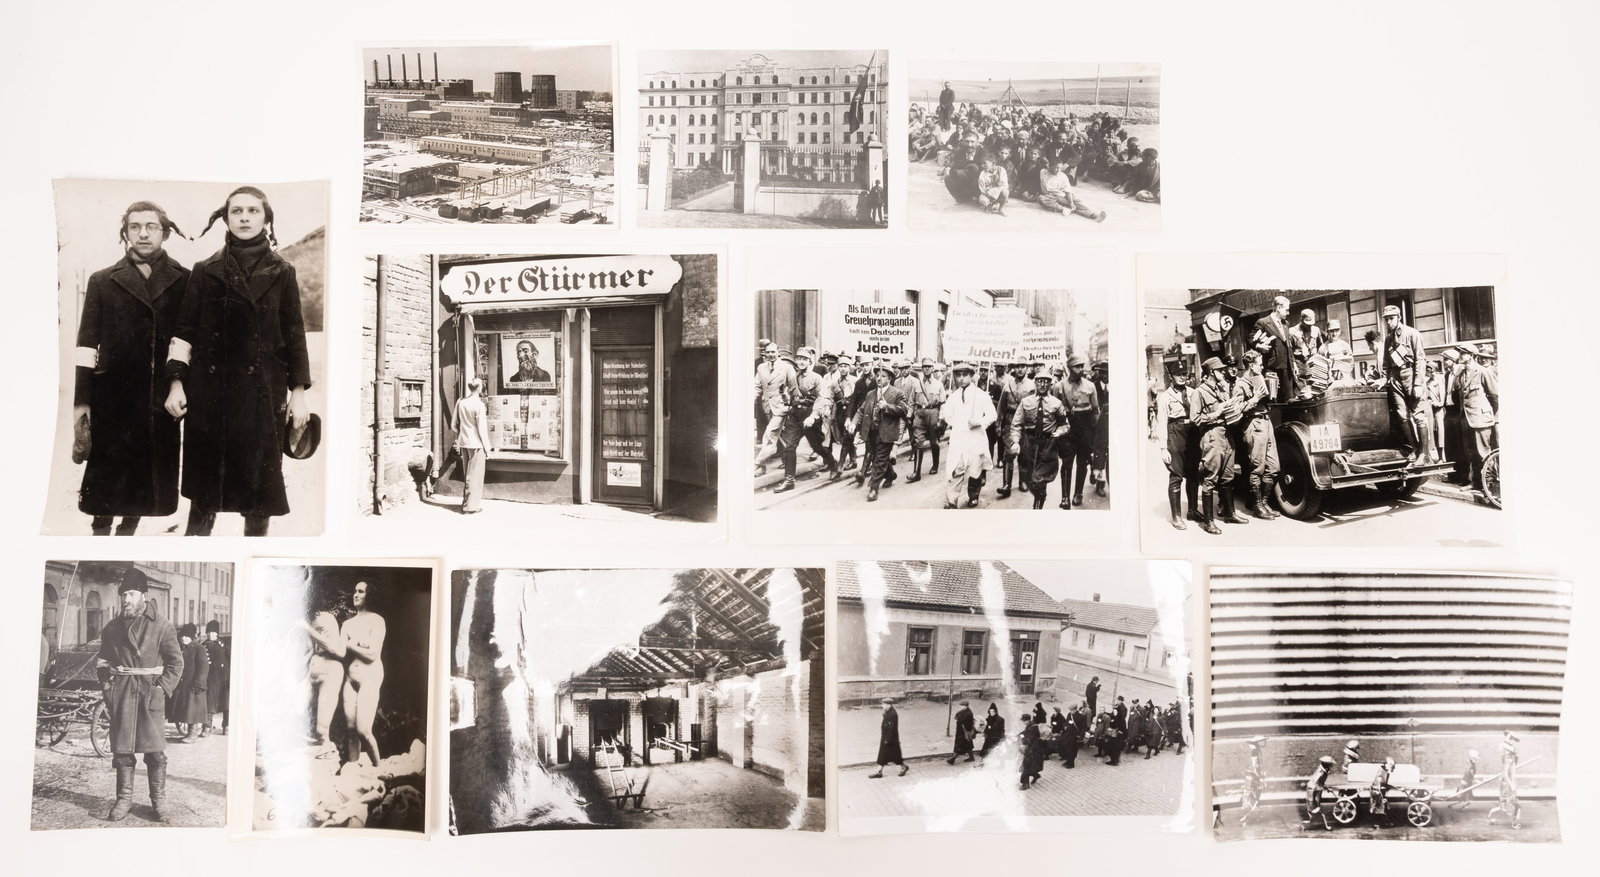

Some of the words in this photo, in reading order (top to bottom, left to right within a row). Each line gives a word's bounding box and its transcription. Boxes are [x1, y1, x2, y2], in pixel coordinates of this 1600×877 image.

[462, 270, 512, 295] Der
[518, 265, 654, 293] Stürmer
[848, 304, 859, 313] Als
[860, 304, 886, 314] Antwort
[887, 306, 898, 314] auf
[899, 306, 911, 315] die
[844, 313, 915, 328] Greuelpropaganda
[870, 327, 911, 335] Deutscher
[856, 340, 904, 354] Juden!
[967, 345, 1016, 360] Juden!
[1028, 351, 1061, 361] Juden!
[1312, 437, 1339, 451] 49764
